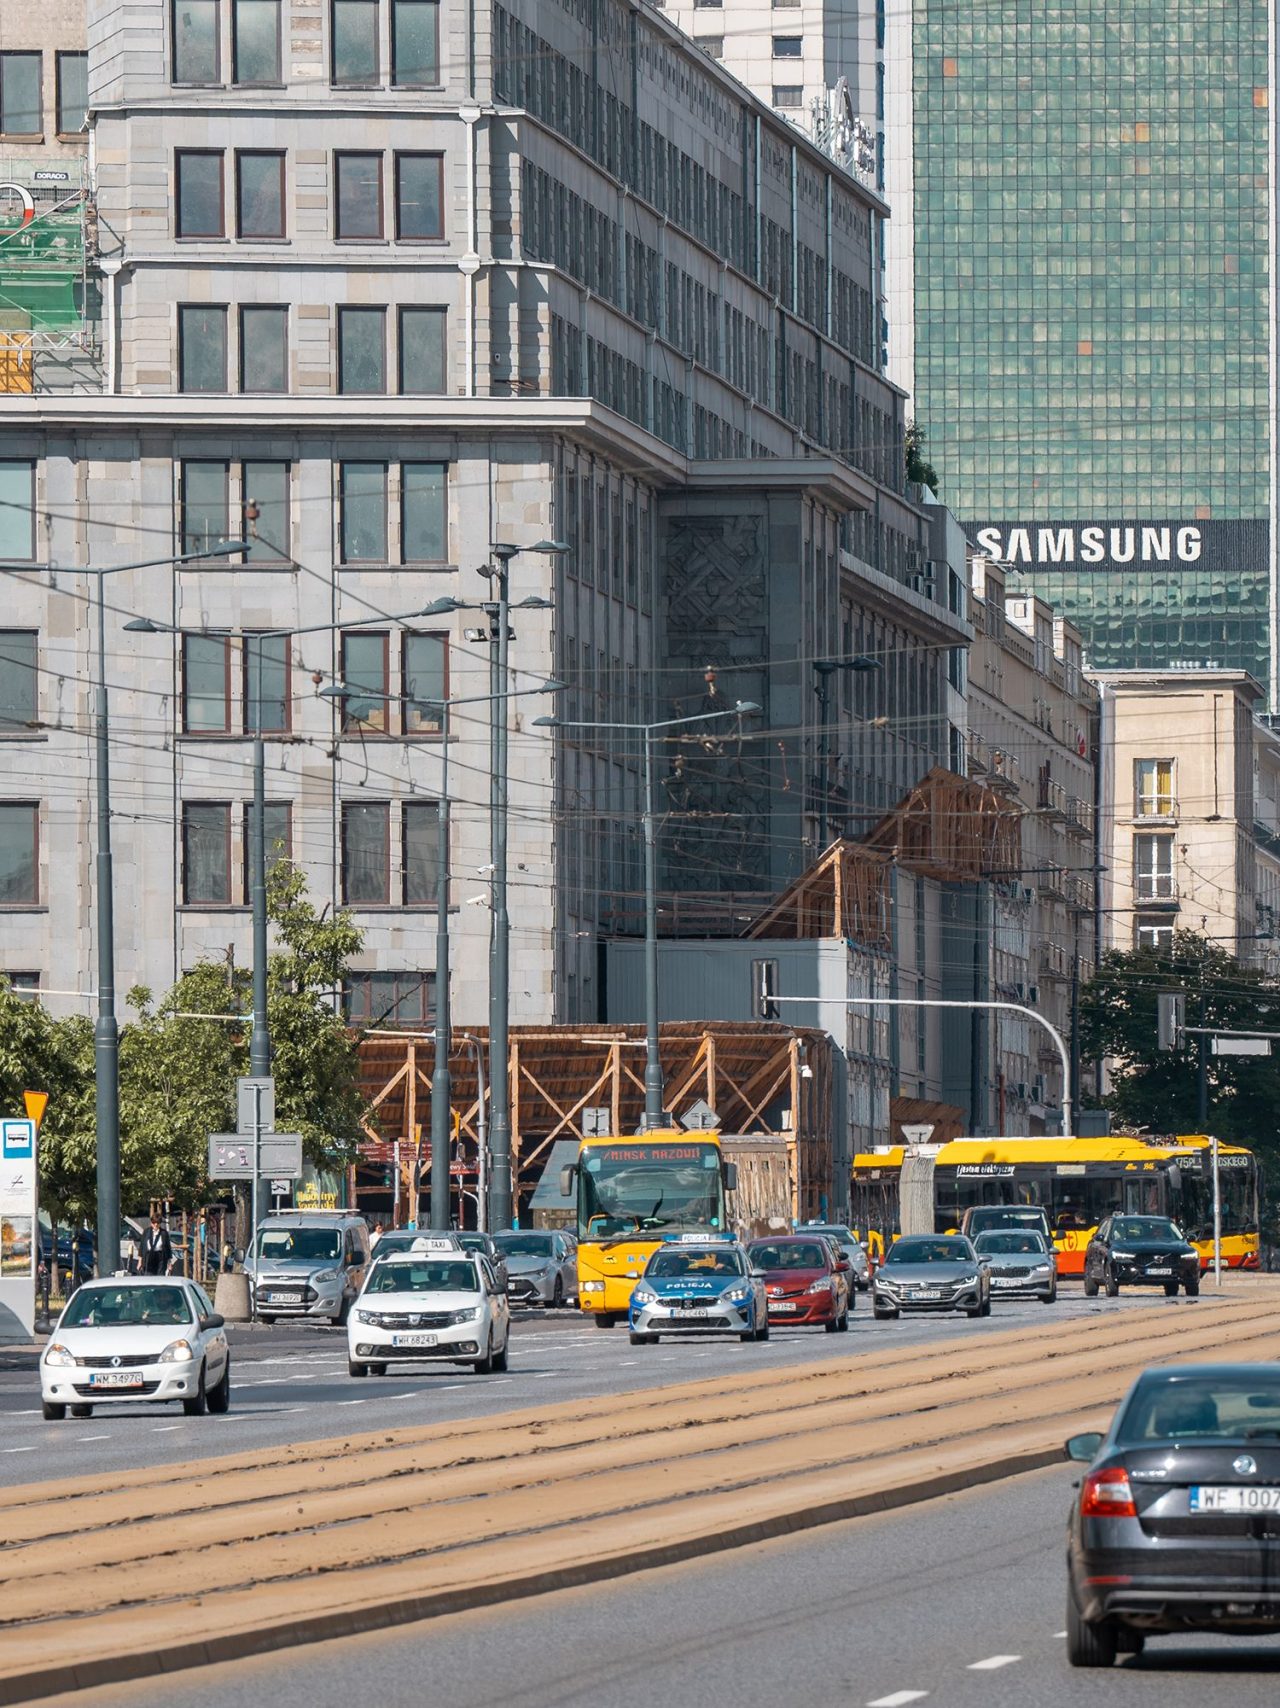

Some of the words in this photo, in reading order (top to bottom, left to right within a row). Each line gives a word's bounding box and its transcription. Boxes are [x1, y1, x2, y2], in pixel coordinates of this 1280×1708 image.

[976, 526, 1202, 563] SAMSUNG
[431, 1241, 446, 1249] TAXI
[666, 1281, 713, 1289] POLICJA
[1203, 1488, 1228, 1509] WF
